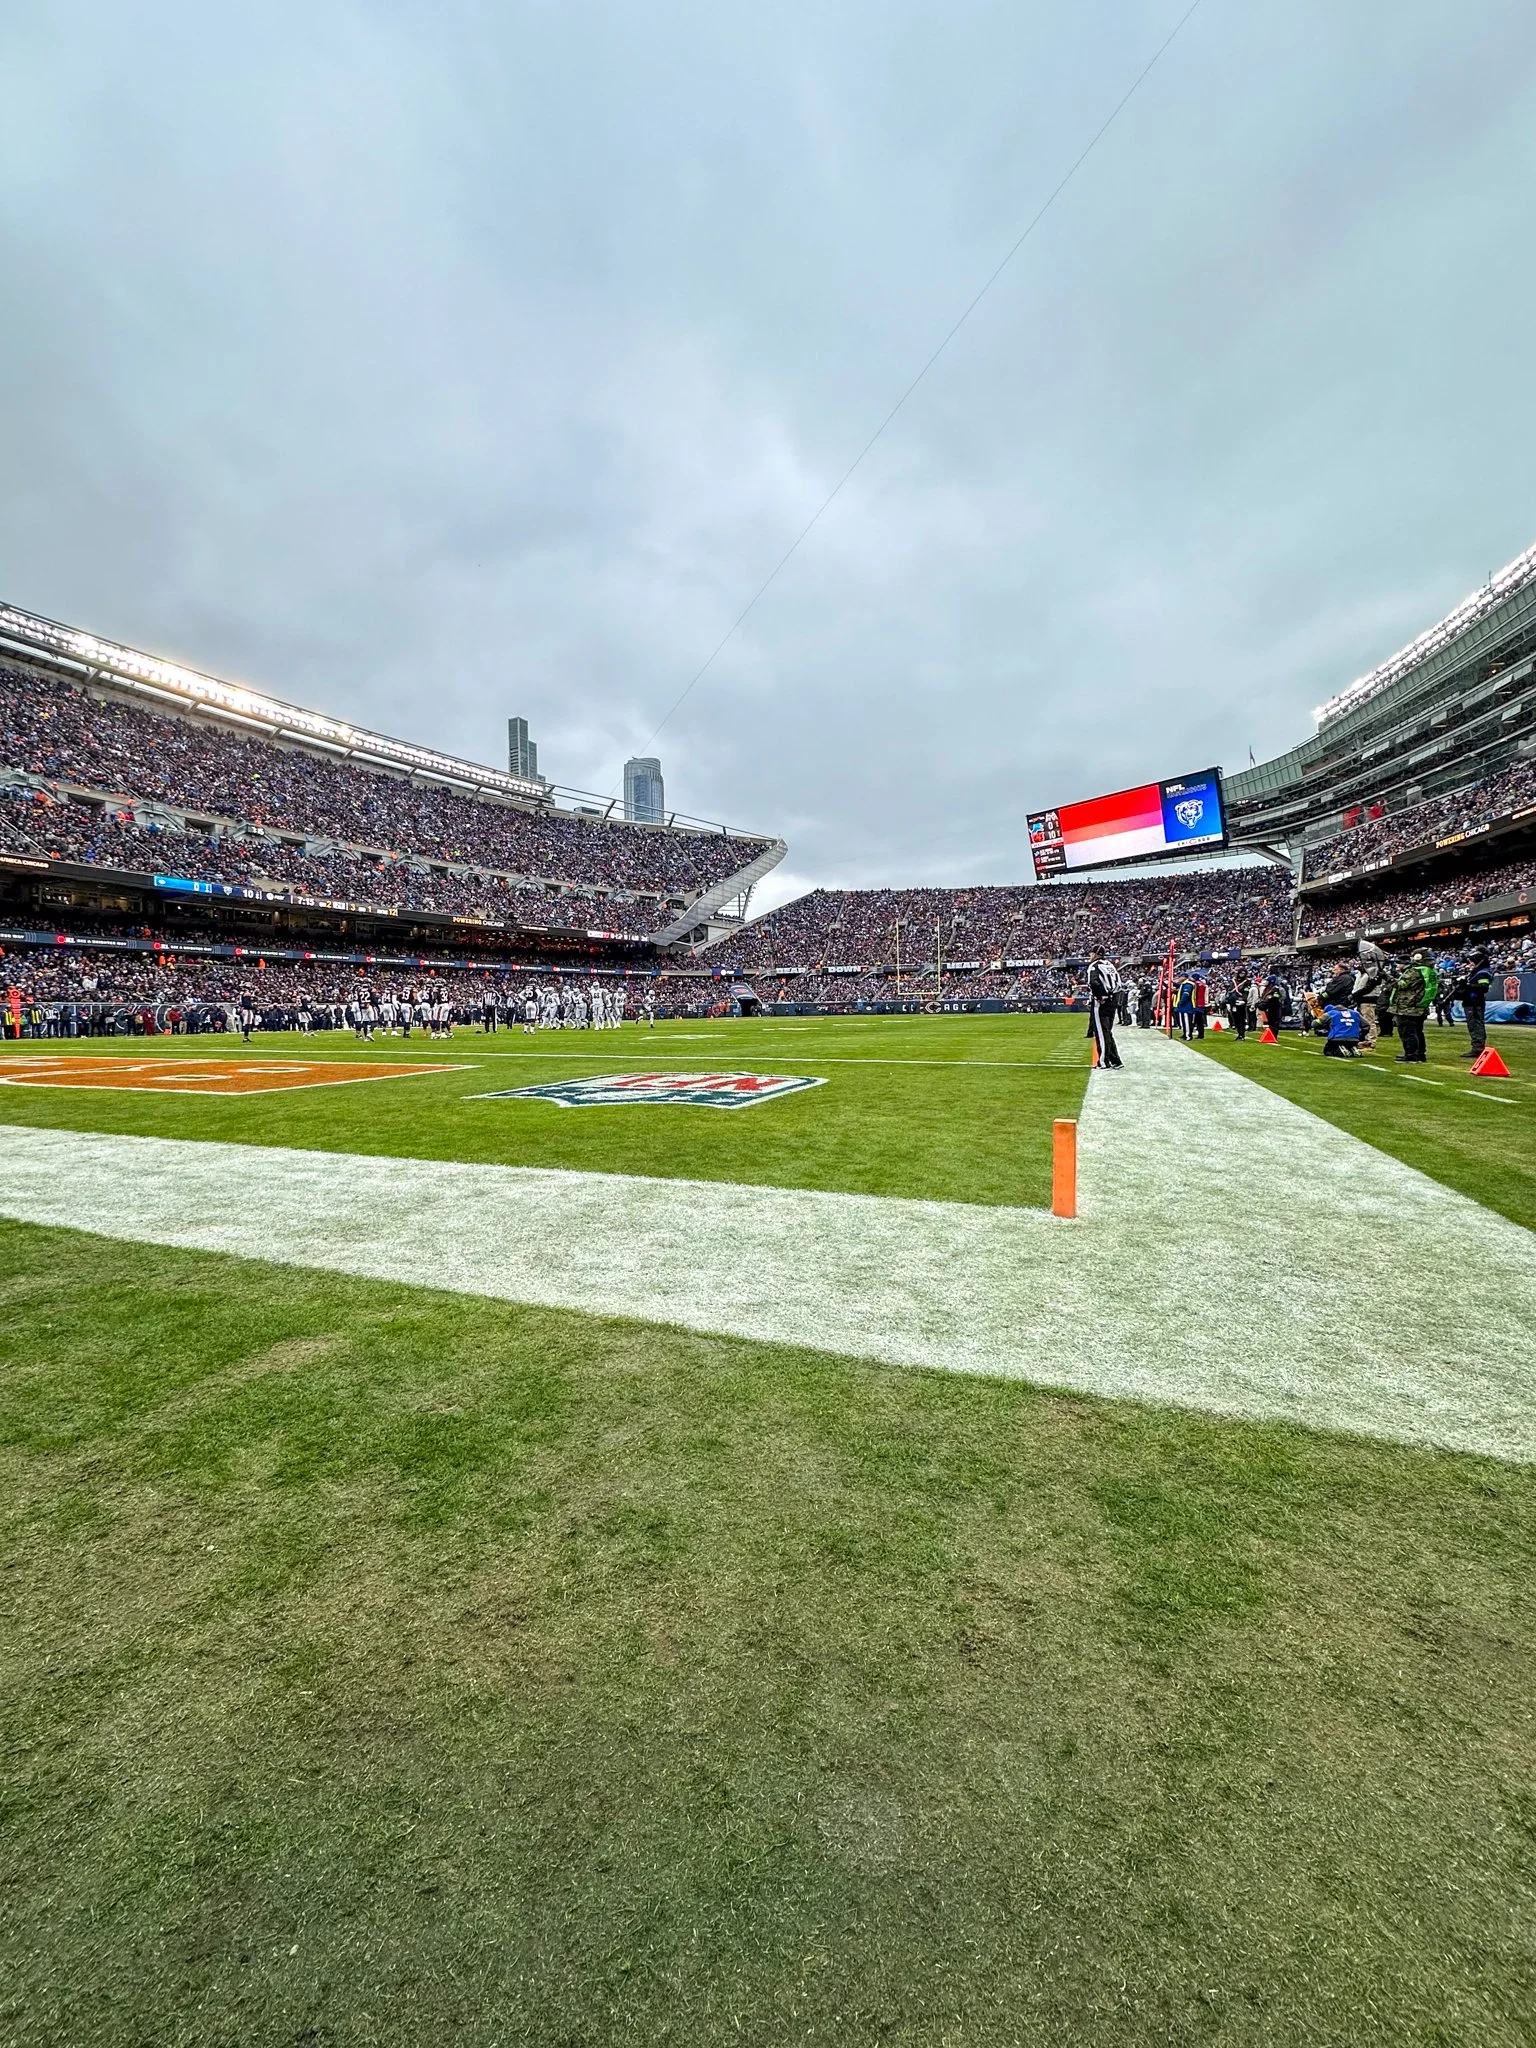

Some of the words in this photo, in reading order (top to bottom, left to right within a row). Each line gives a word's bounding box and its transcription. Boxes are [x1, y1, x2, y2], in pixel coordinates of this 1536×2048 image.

[1165, 783, 1185, 793] NFL
[1435, 832, 1465, 848] POWERING
[1465, 824, 1490, 838] CHICAGO
[243, 889, 254, 898] 10
[297, 896, 315, 906] 7:15
[1458, 907, 1470, 917] PNC
[452, 916, 482, 925] POWERING
[483, 920, 504, 928] CHICAGO
[1006, 959, 1044, 967] DOWN
[359, 991, 371, 1002] 22
